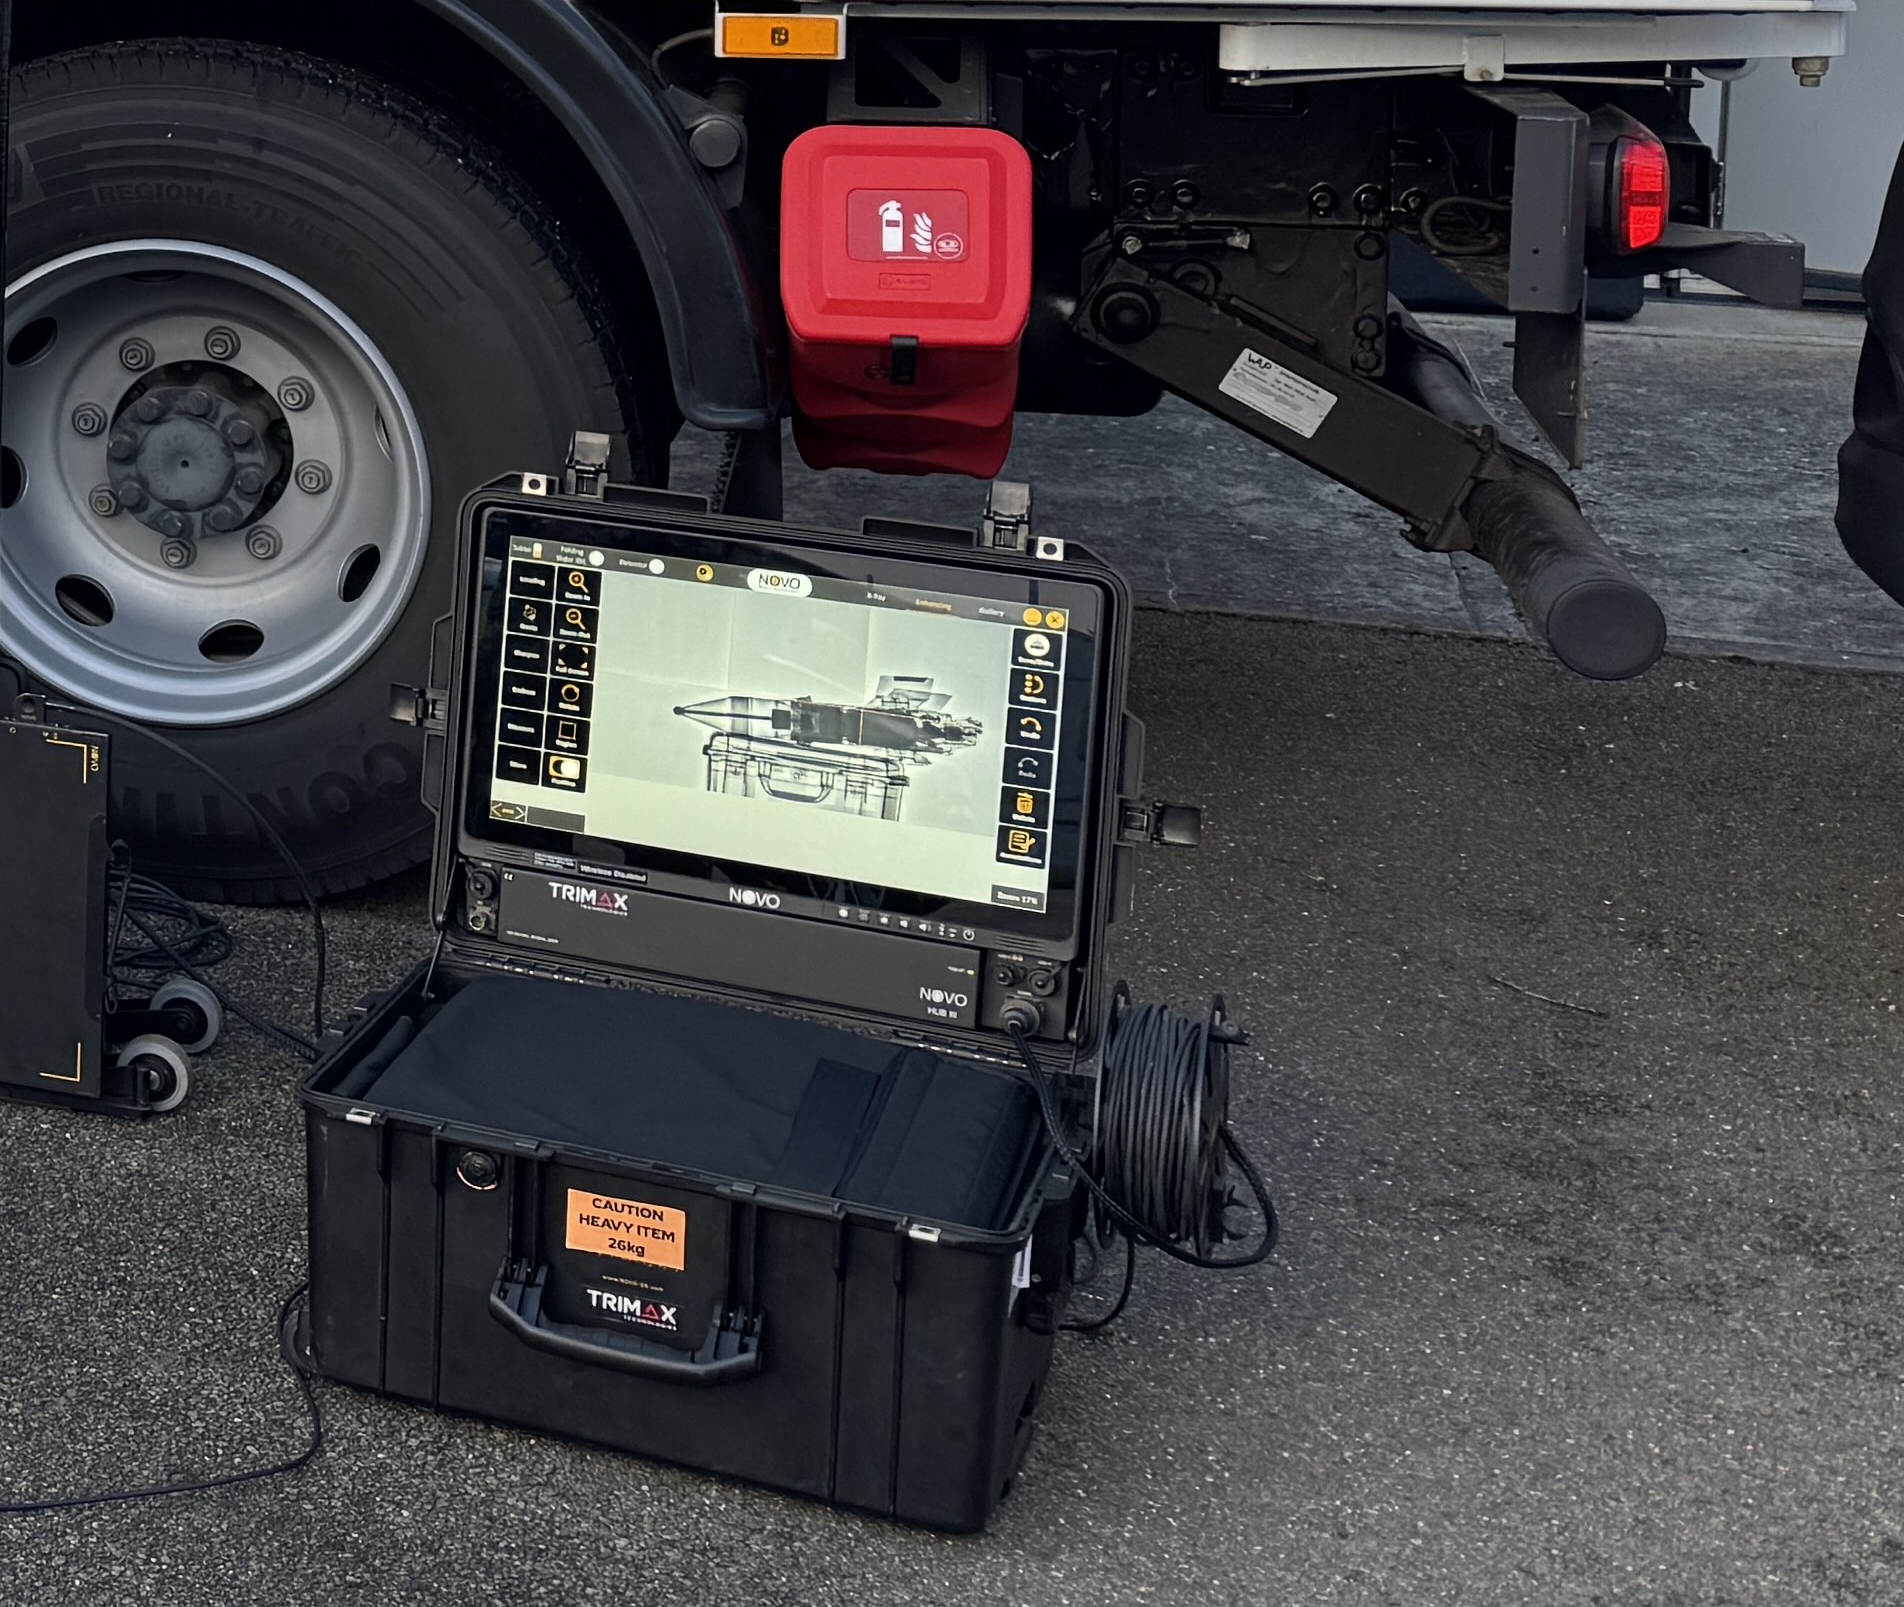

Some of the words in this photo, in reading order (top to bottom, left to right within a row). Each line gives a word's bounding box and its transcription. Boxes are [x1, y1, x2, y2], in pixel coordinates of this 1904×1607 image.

[758, 573, 801, 590] NOVO
[729, 887, 781, 909] NOVO
[919, 986, 968, 1007] NOVO
[592, 1197, 664, 1222] CAUTION
[579, 1213, 634, 1234] HEAVY
[637, 1225, 675, 1243] ITEM
[608, 1237, 646, 1258] 26kg
